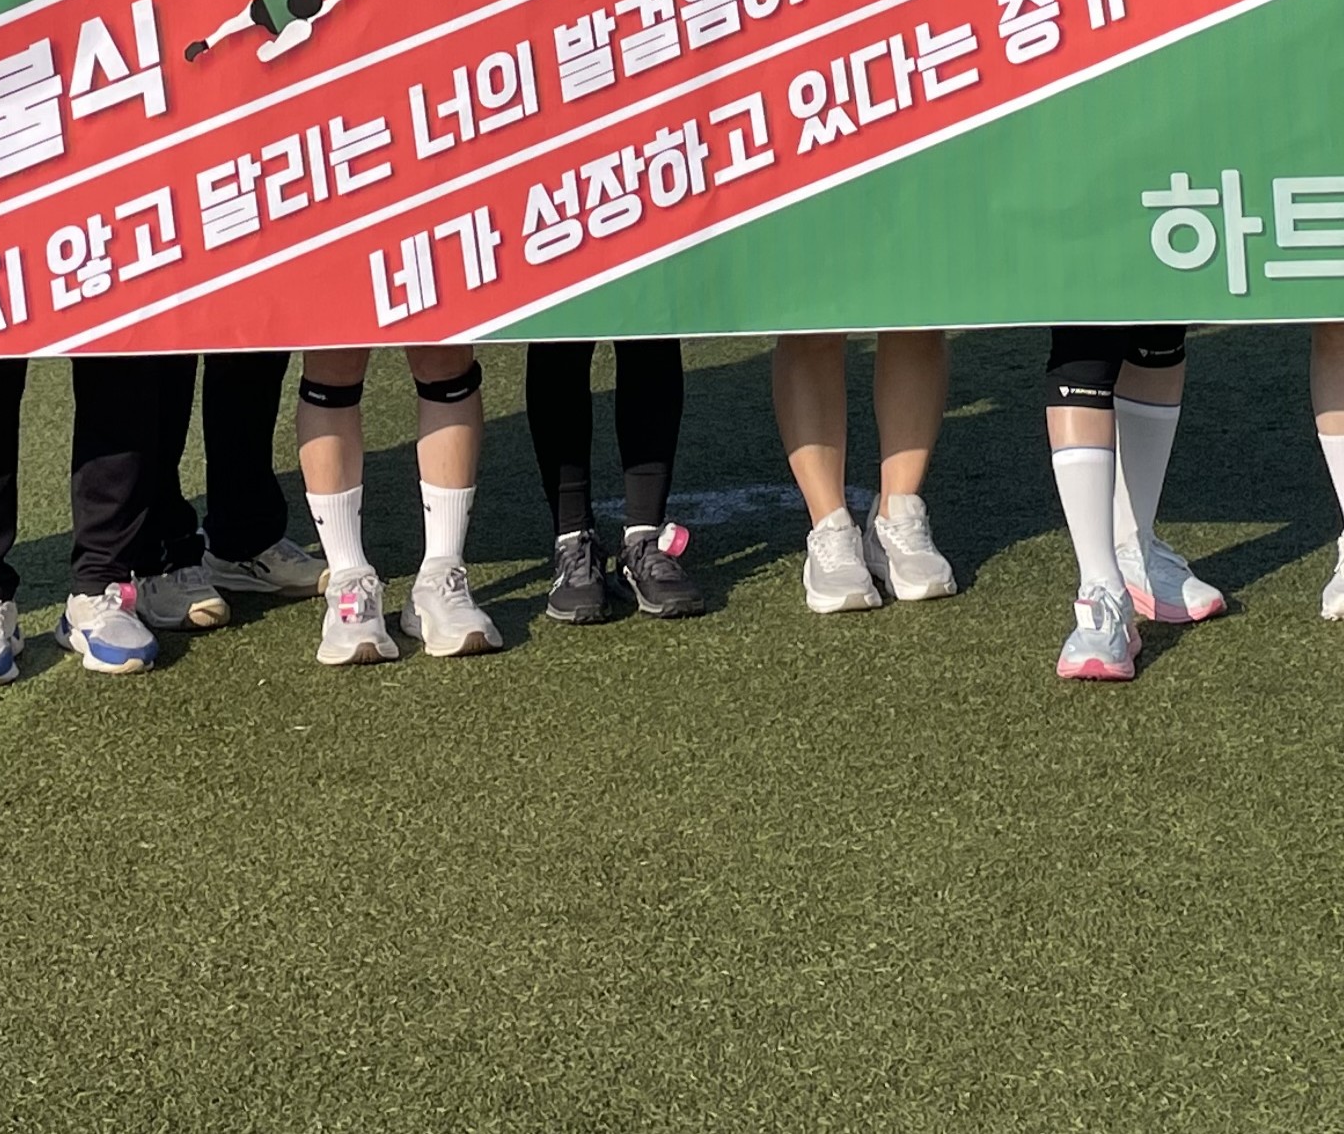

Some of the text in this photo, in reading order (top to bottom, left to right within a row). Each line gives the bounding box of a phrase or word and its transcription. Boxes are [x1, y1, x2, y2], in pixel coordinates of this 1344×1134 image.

[46, 186, 183, 312] 않고
[196, 114, 393, 251] 달리는
[409, 40, 539, 160] 너의
[369, 206, 502, 328] 네가
[522, 92, 775, 266] 성장하고
[788, 23, 979, 155] 있다는
